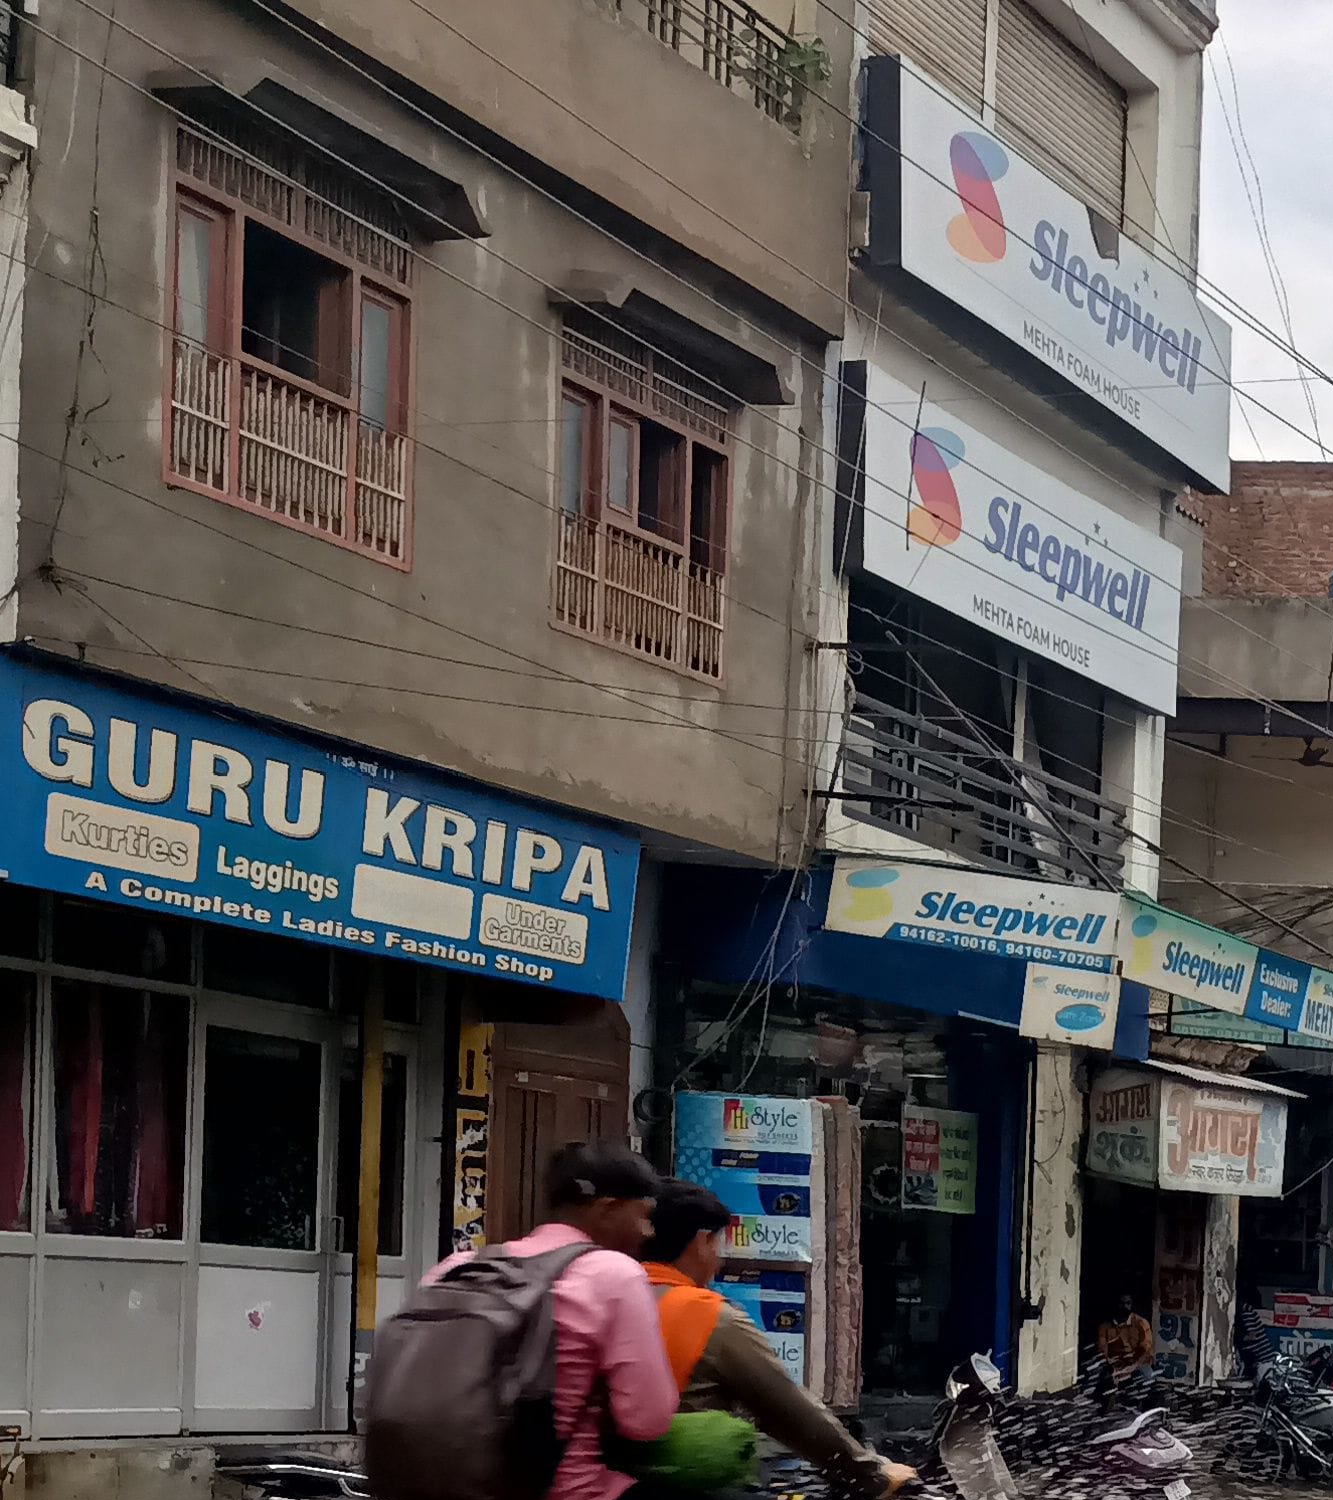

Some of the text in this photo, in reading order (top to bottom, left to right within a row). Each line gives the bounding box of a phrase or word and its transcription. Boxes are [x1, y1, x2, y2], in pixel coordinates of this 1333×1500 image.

[1029, 219, 1202, 395] Sleepwell
[1023, 320, 1141, 421] MEHTA FOAM HOUSE
[983, 496, 1151, 630] Sleepwell
[972, 594, 1091, 669] MEHTA FOAM HOUSE
[22, 698, 611, 912] GURU KRIPA
[61, 809, 190, 867] Kurties
[216, 845, 340, 902] Laggings
[85, 870, 554, 982] A Complete Ladies Fashion Shop
[483, 918, 582, 958] Garments
[506, 902, 567, 936] Under
[914, 891, 1107, 945] Sleepwell
[1162, 940, 1246, 995] Sleepwell
[1259, 963, 1300, 994] Exclusive
[1260, 990, 1293, 1019] Dealer:
